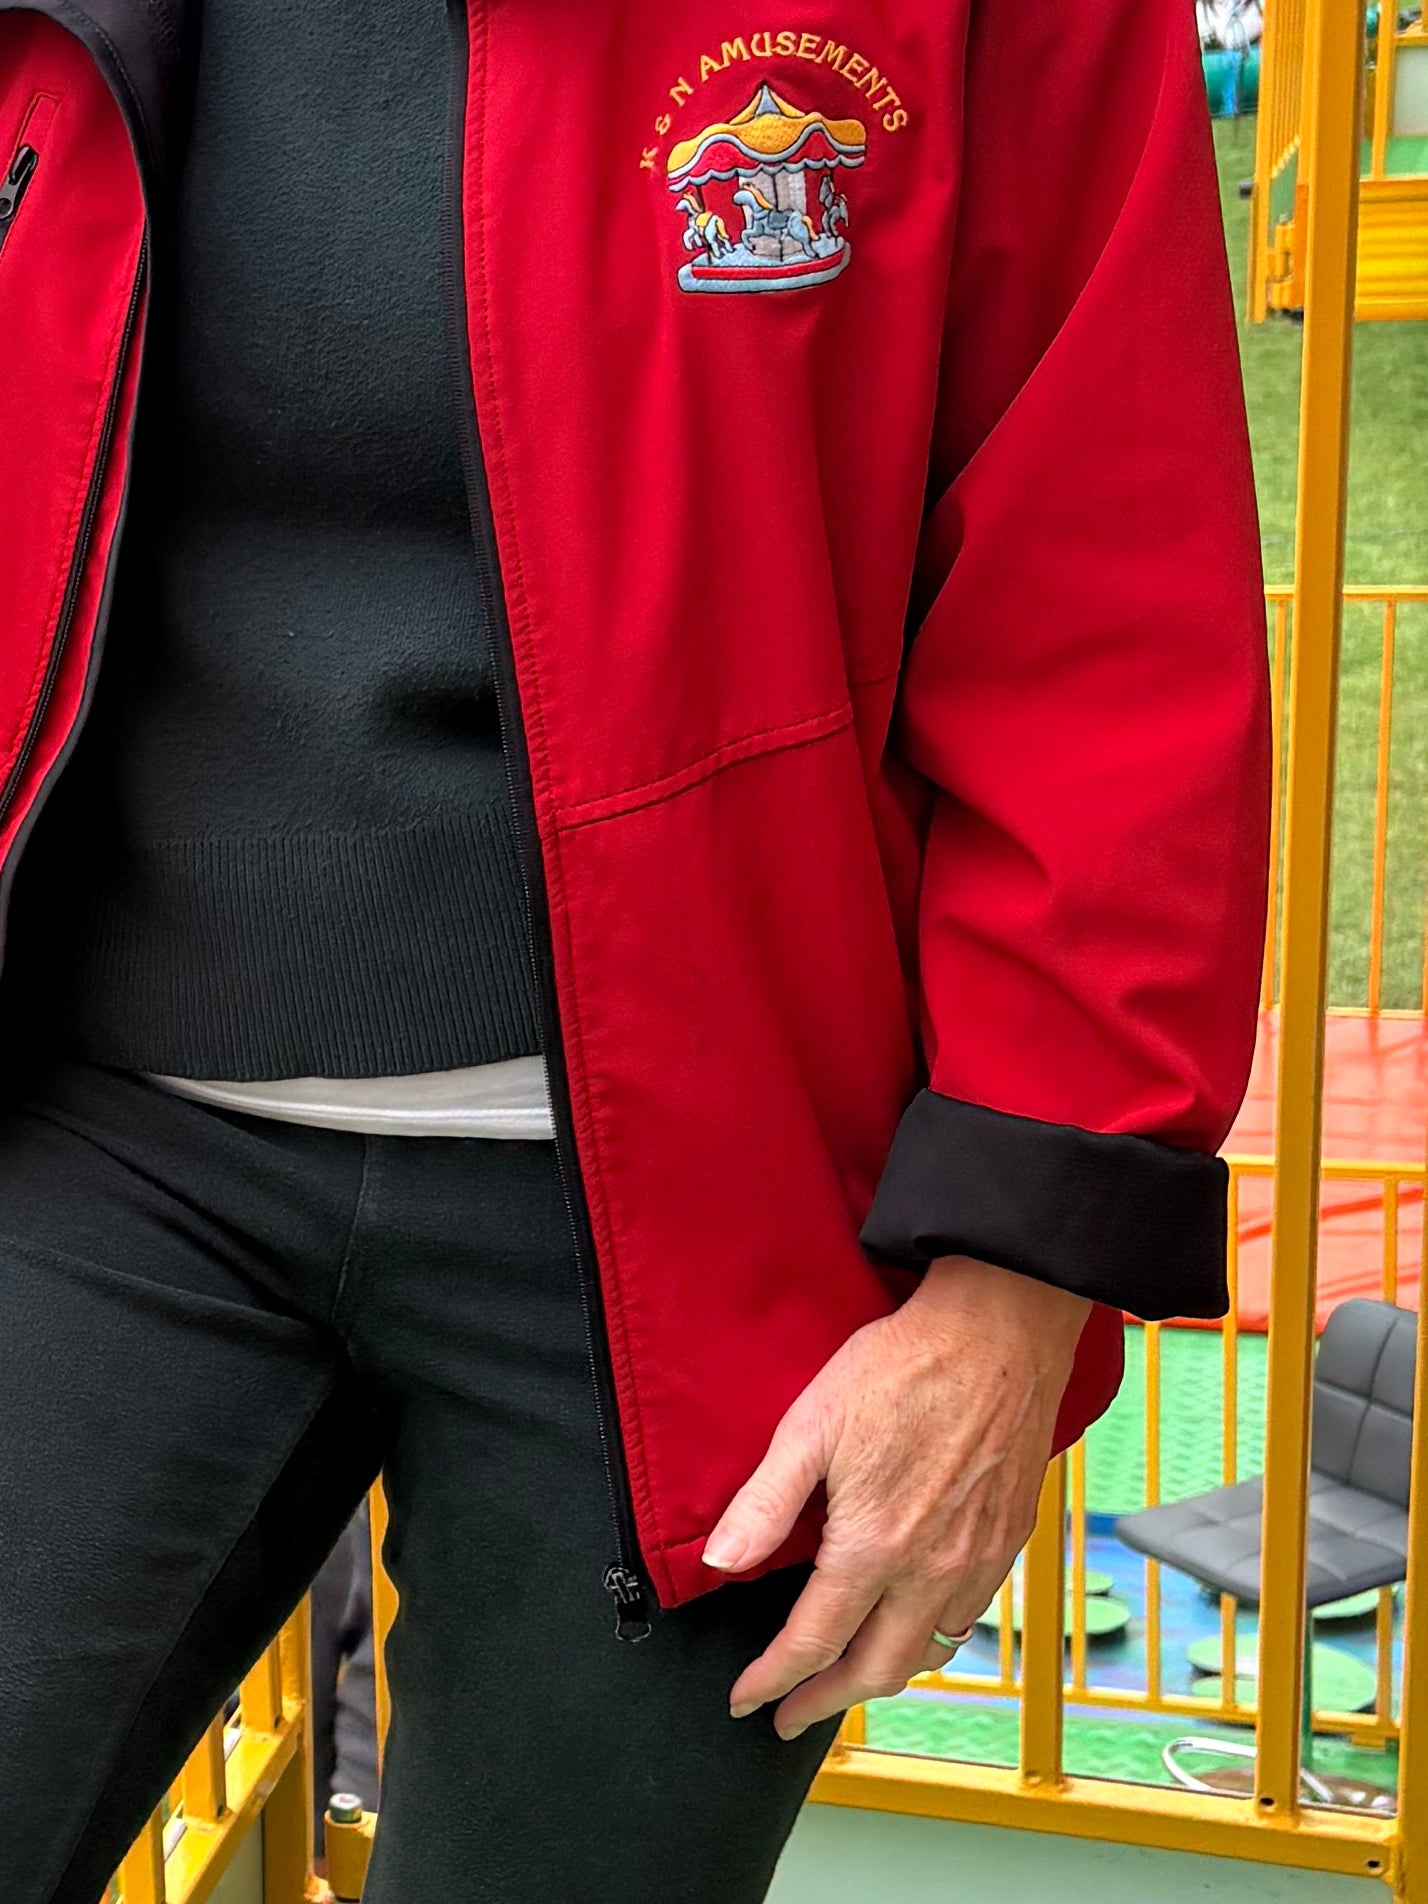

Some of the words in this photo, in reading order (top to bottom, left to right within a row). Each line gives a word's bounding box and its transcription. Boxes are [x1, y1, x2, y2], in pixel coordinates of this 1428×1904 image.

[639, 146, 659, 170] K
[655, 112, 672, 136] &
[669, 76, 694, 107] N
[698, 30, 909, 133] AMUSEMENTS
